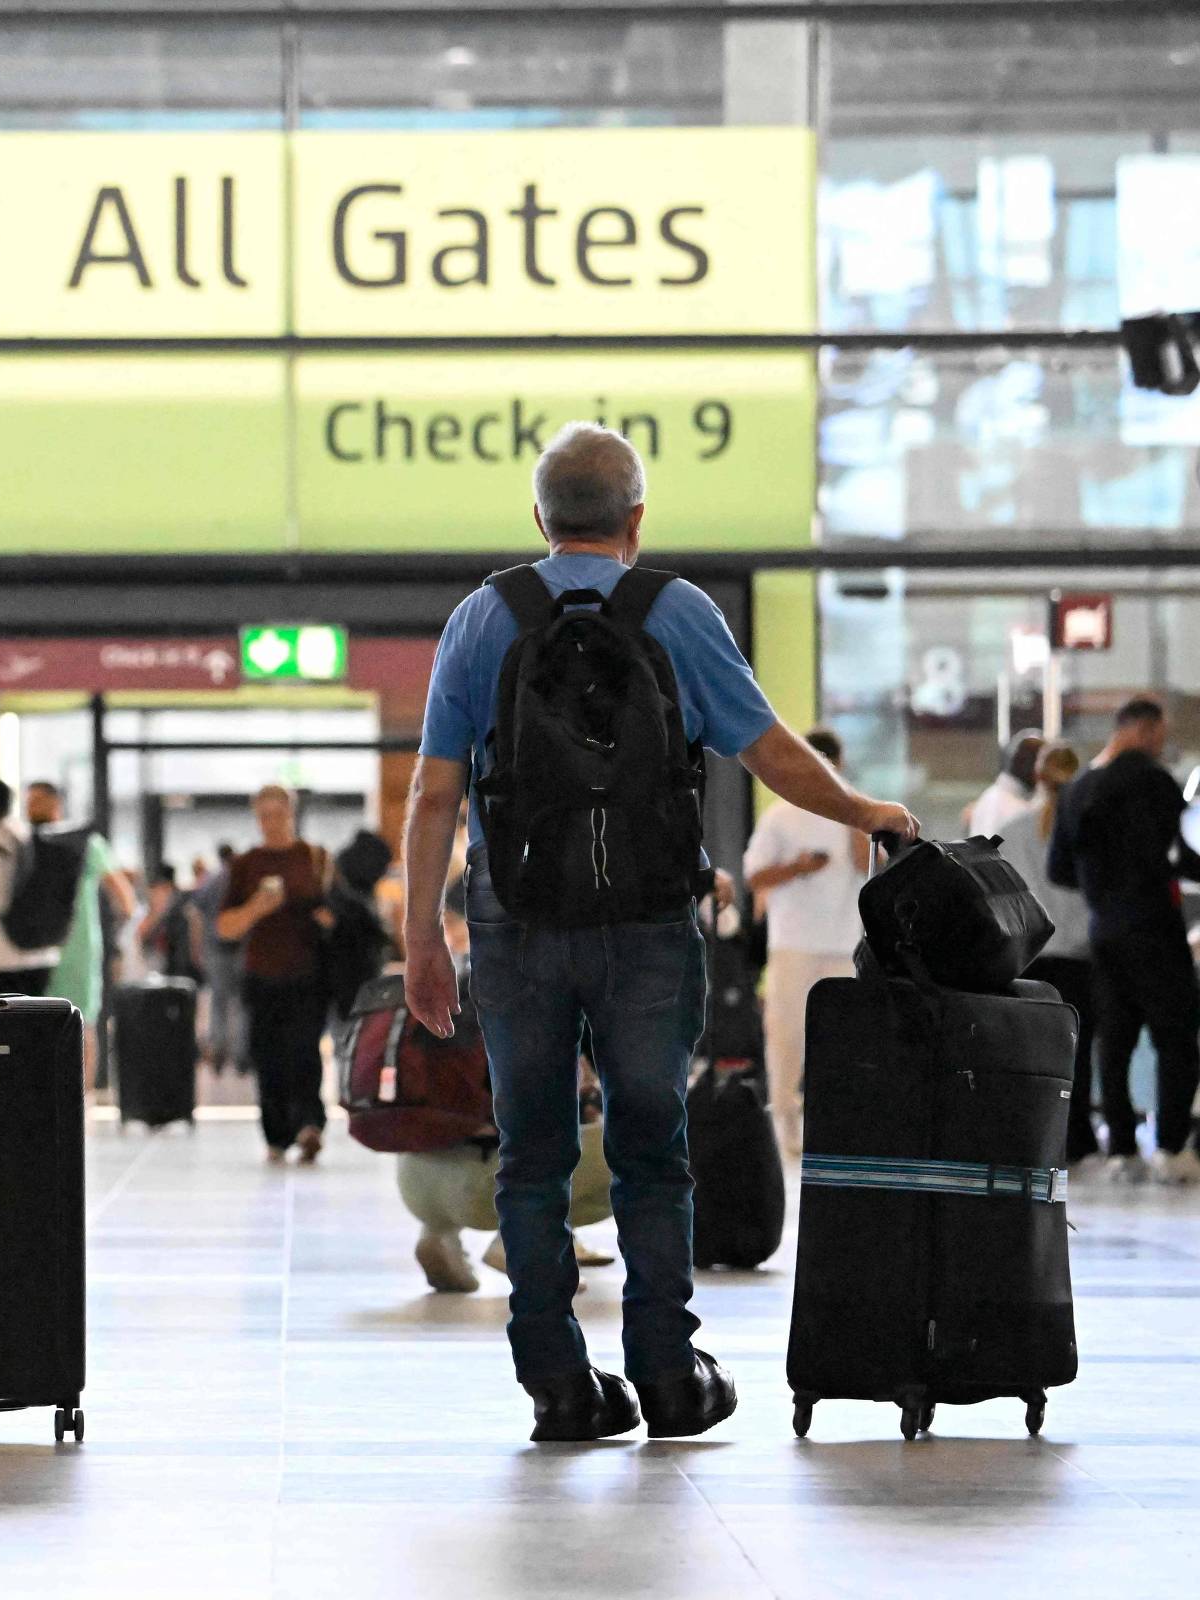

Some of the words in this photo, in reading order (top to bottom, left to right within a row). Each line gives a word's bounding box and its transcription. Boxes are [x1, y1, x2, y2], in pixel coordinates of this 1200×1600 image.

[68, 176, 248, 289] All
[332, 183, 711, 289] Gates
[325, 399, 545, 462] Check
[692, 400, 733, 460] 9
